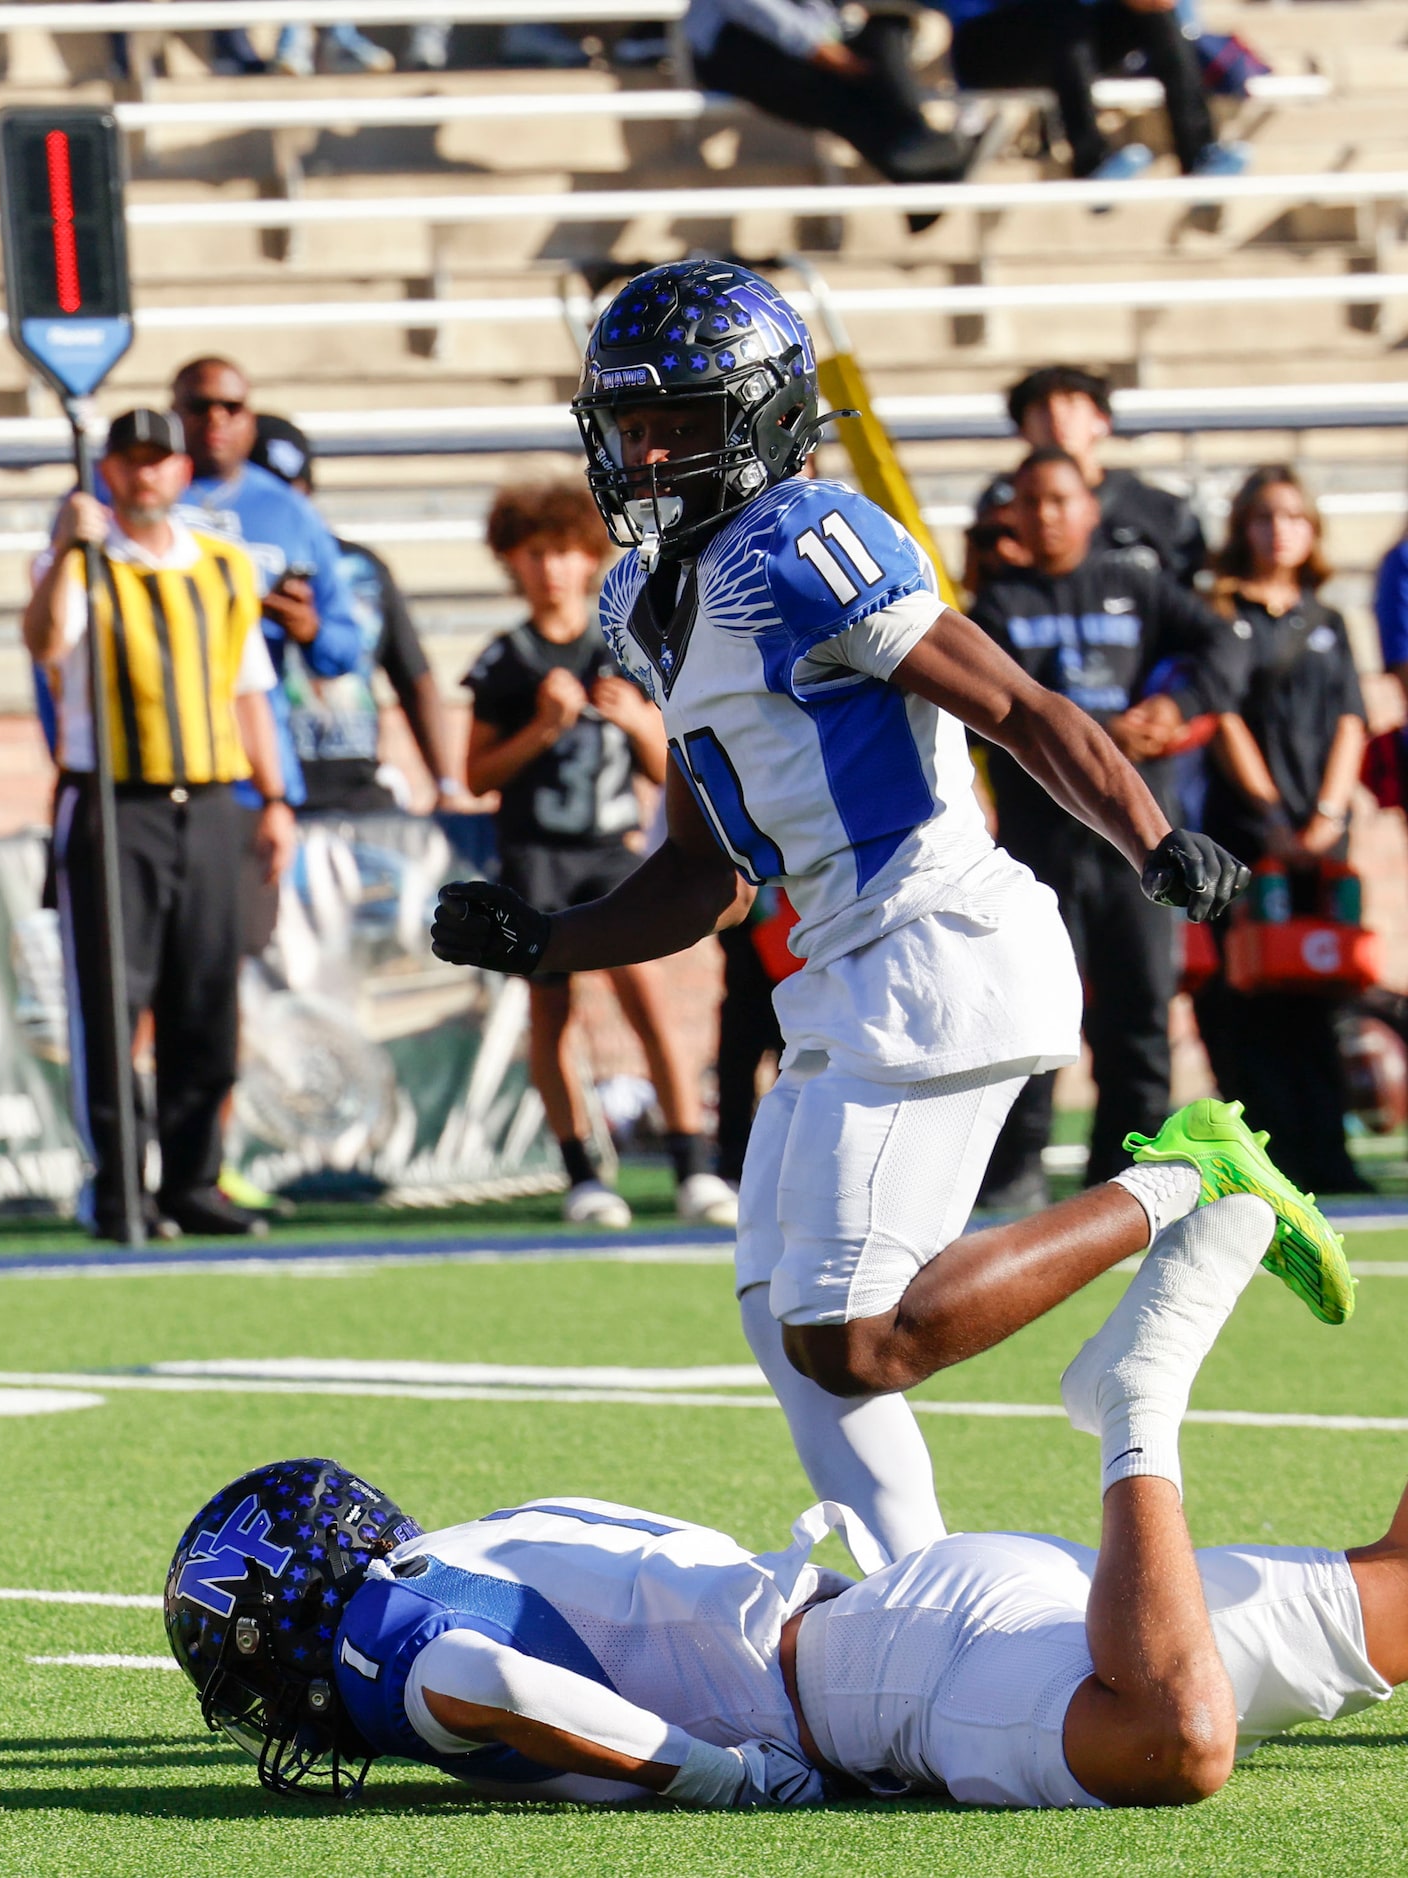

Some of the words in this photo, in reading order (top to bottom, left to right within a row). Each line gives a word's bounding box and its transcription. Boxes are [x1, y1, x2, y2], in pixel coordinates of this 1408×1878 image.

[794, 509, 886, 608] 11
[534, 720, 638, 834] 32
[175, 1493, 294, 1618] NF
